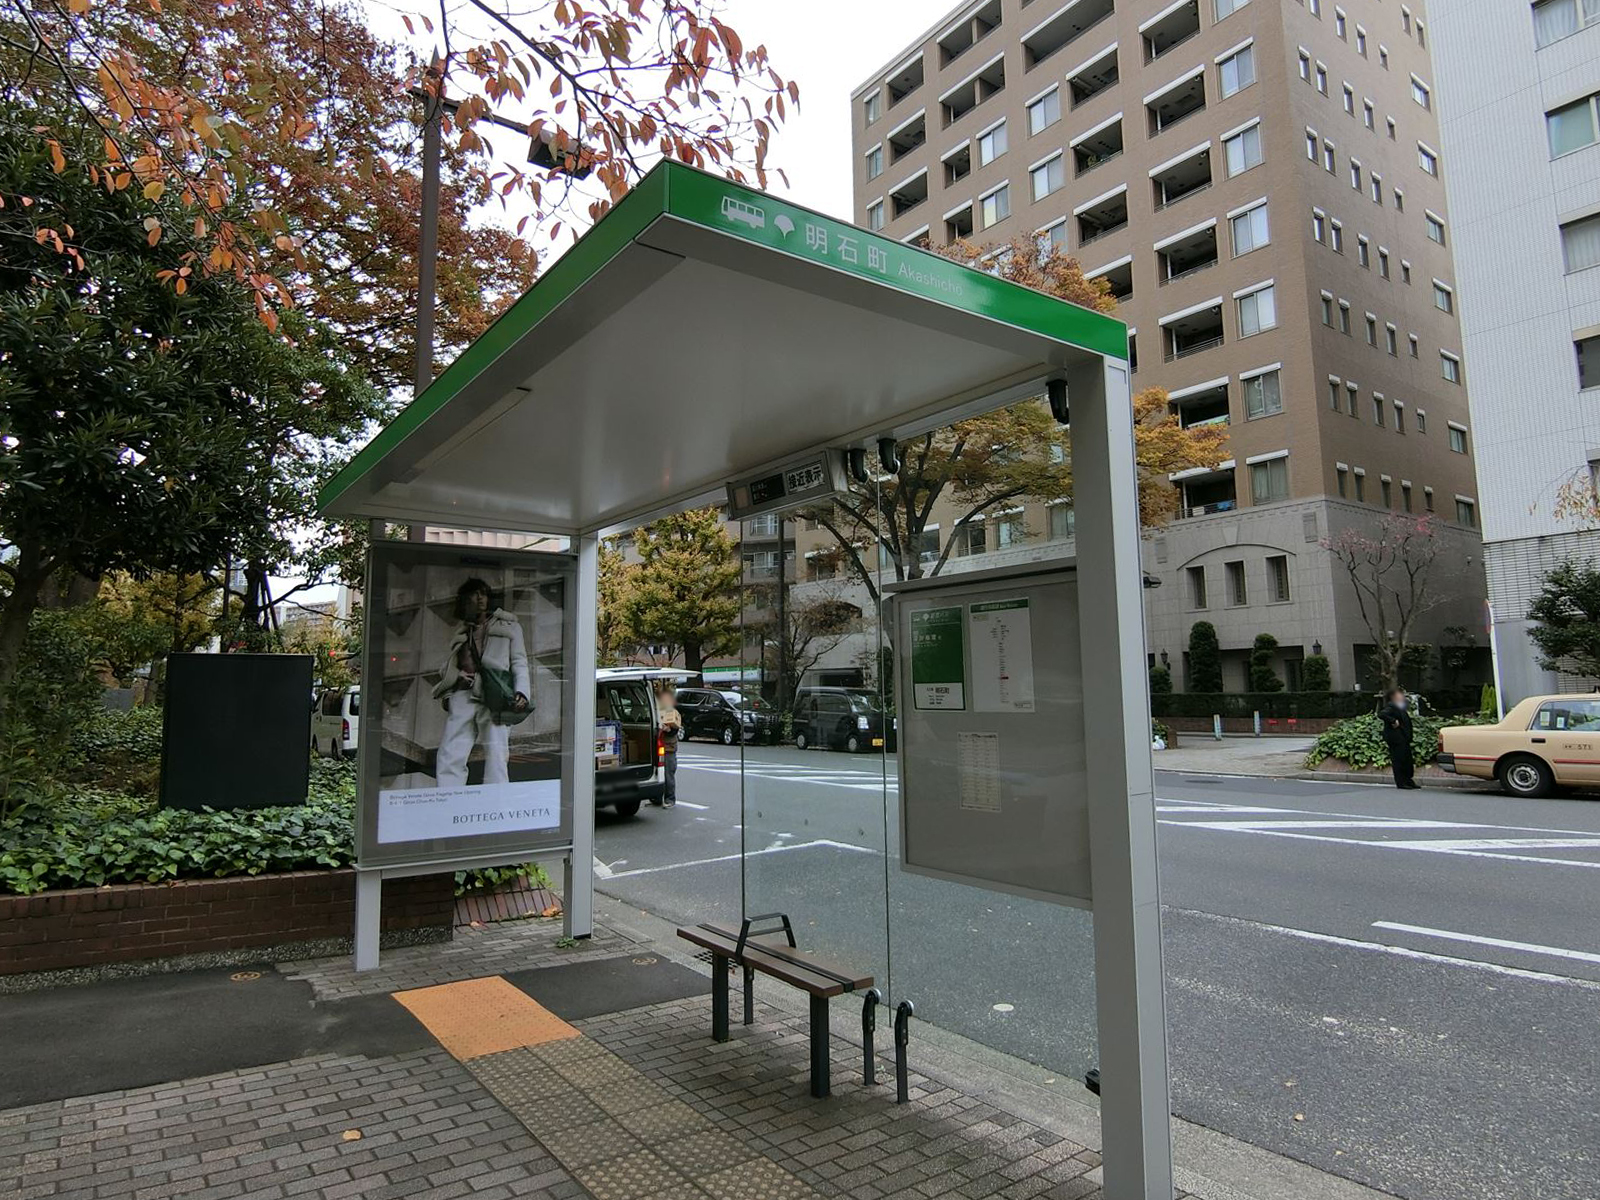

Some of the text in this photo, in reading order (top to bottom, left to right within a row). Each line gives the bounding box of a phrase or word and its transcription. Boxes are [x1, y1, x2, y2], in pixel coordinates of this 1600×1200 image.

[805, 223, 887, 275] 明石町
[898, 262, 963, 296] Akashicho
[788, 466, 822, 489] 接近表示
[453, 808, 550, 824] BOTTEGA VENETA
